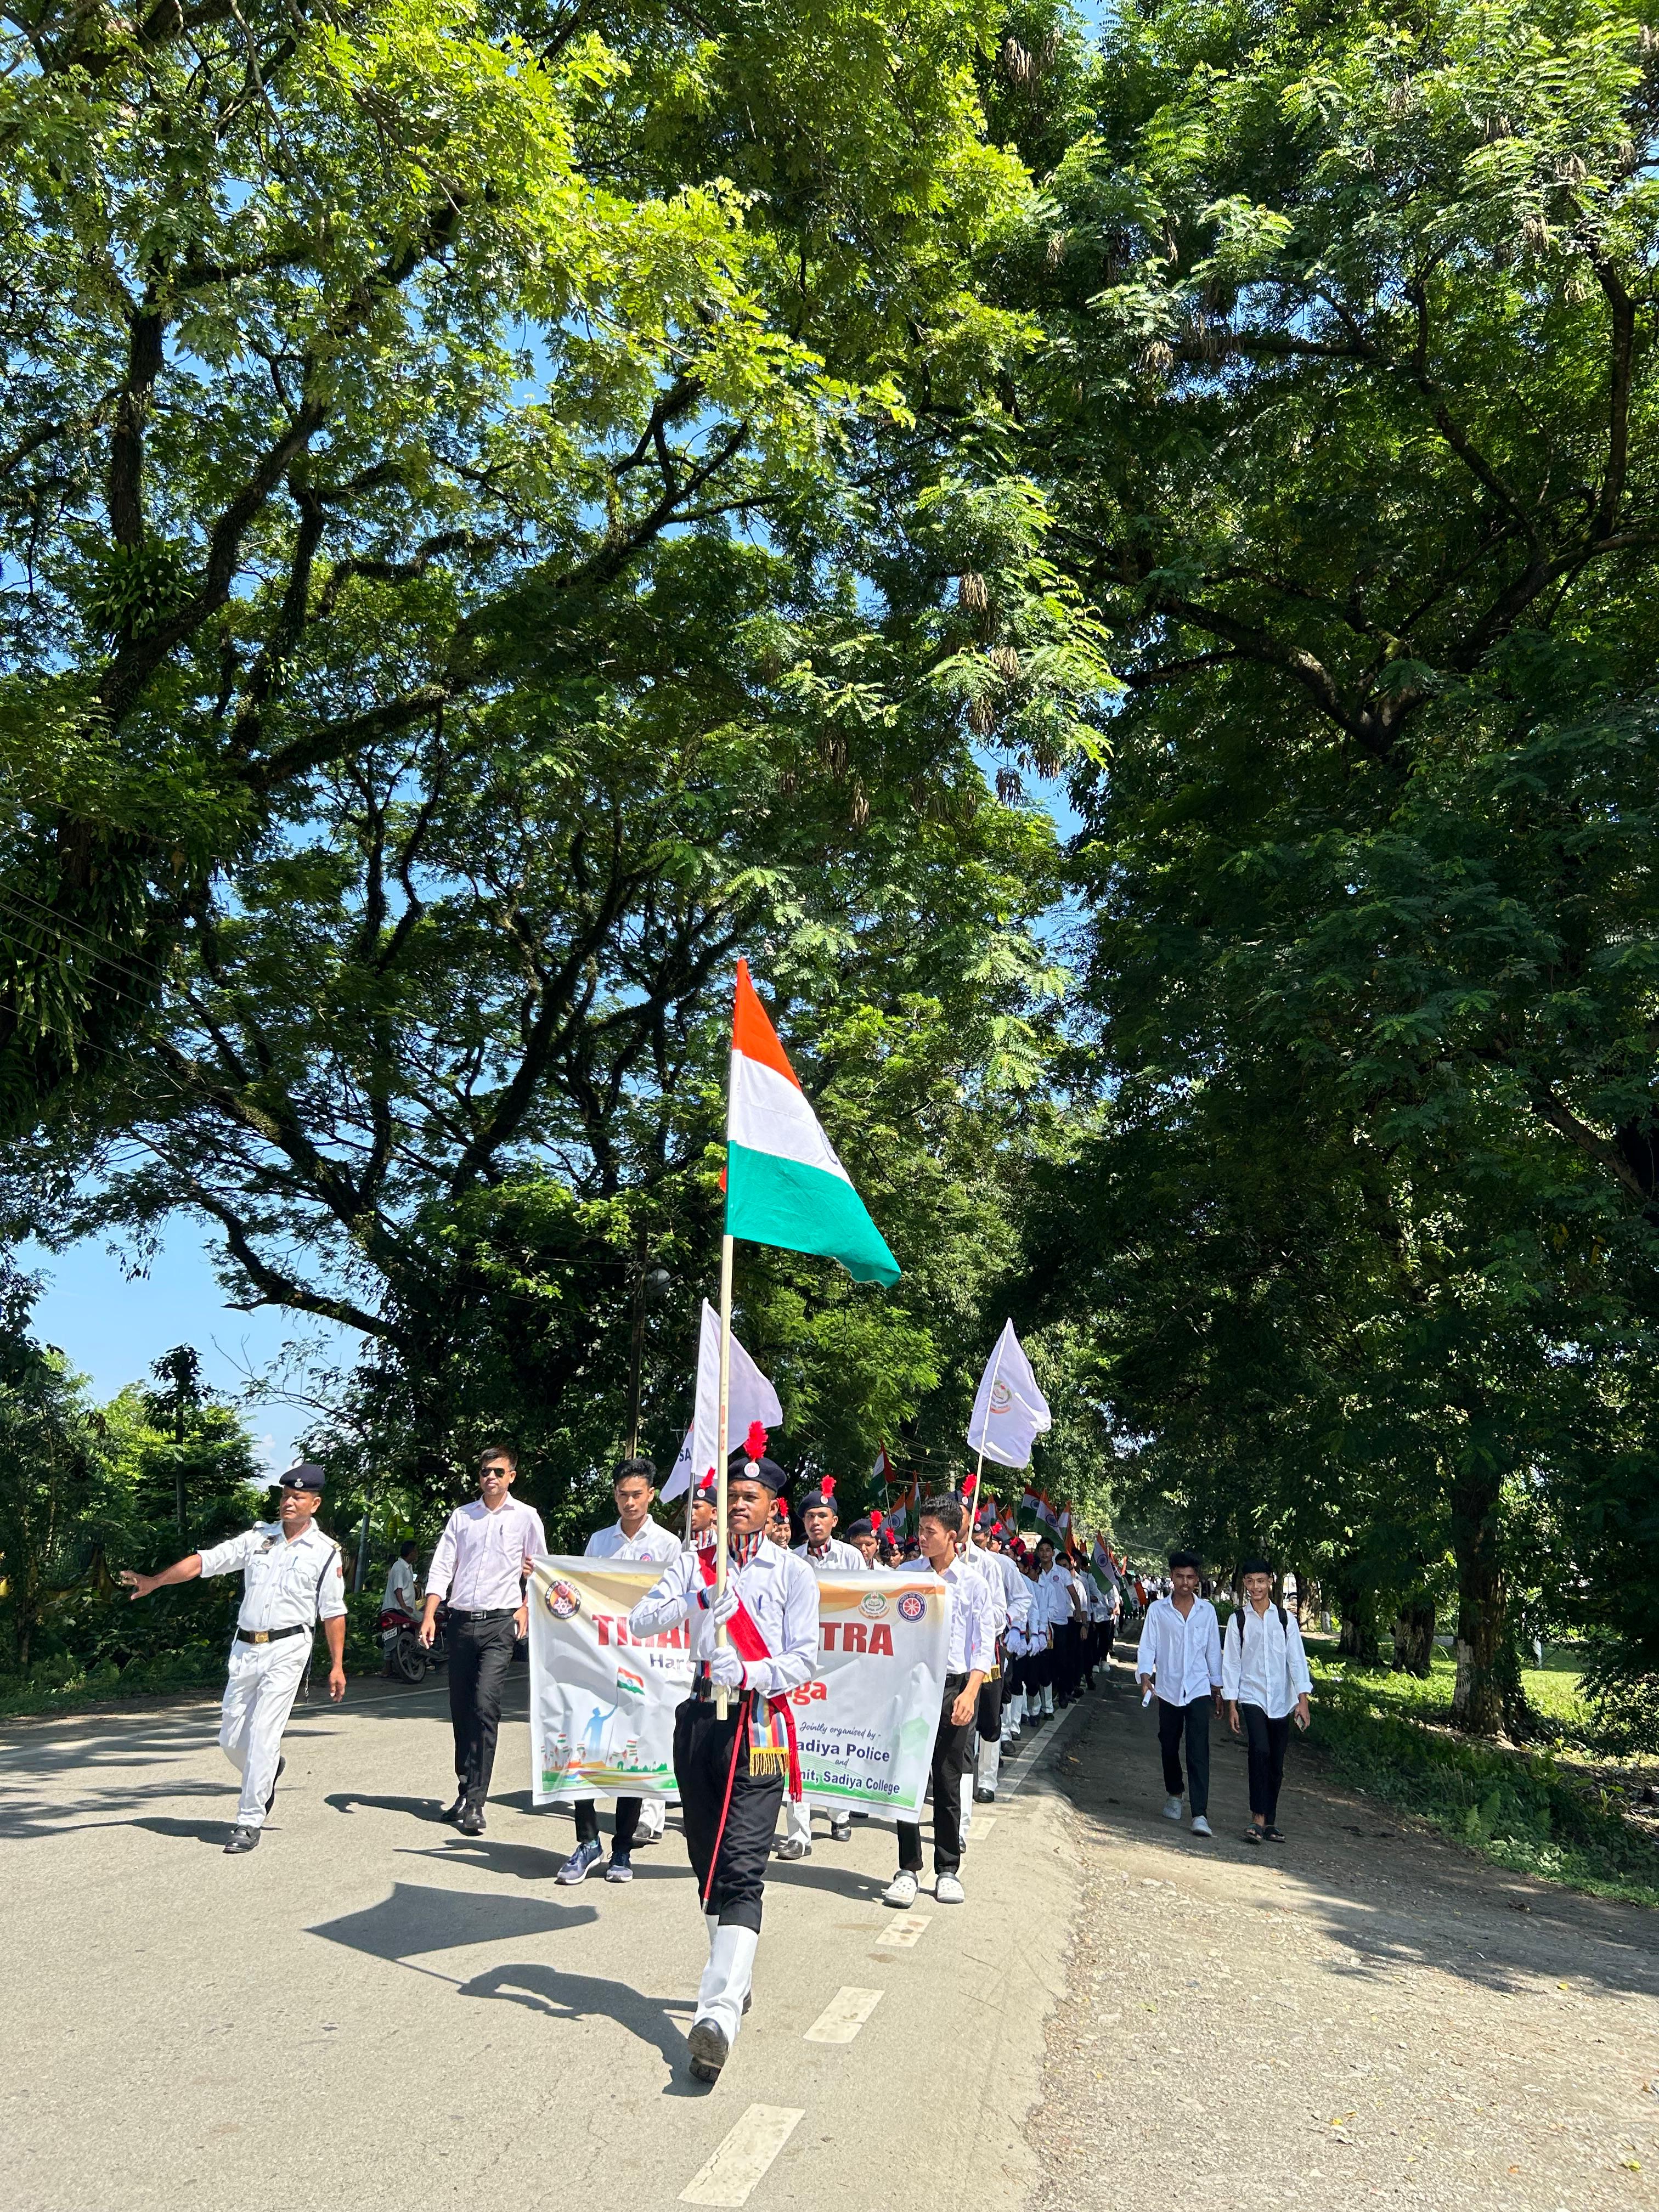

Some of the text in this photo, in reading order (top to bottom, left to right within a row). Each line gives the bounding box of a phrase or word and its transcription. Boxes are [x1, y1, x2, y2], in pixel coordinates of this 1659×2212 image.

[679, 1447, 692, 1462] SA
[818, 1622, 894, 1656] TRA
[799, 1722, 827, 1734] Jointly
[830, 1727, 867, 1739] organised
[867, 1729, 876, 1741] by
[797, 1739, 890, 1762] adiya Police
[835, 1758, 849, 1769] and
[800, 1769, 900, 1796] nit, Sadiya College
